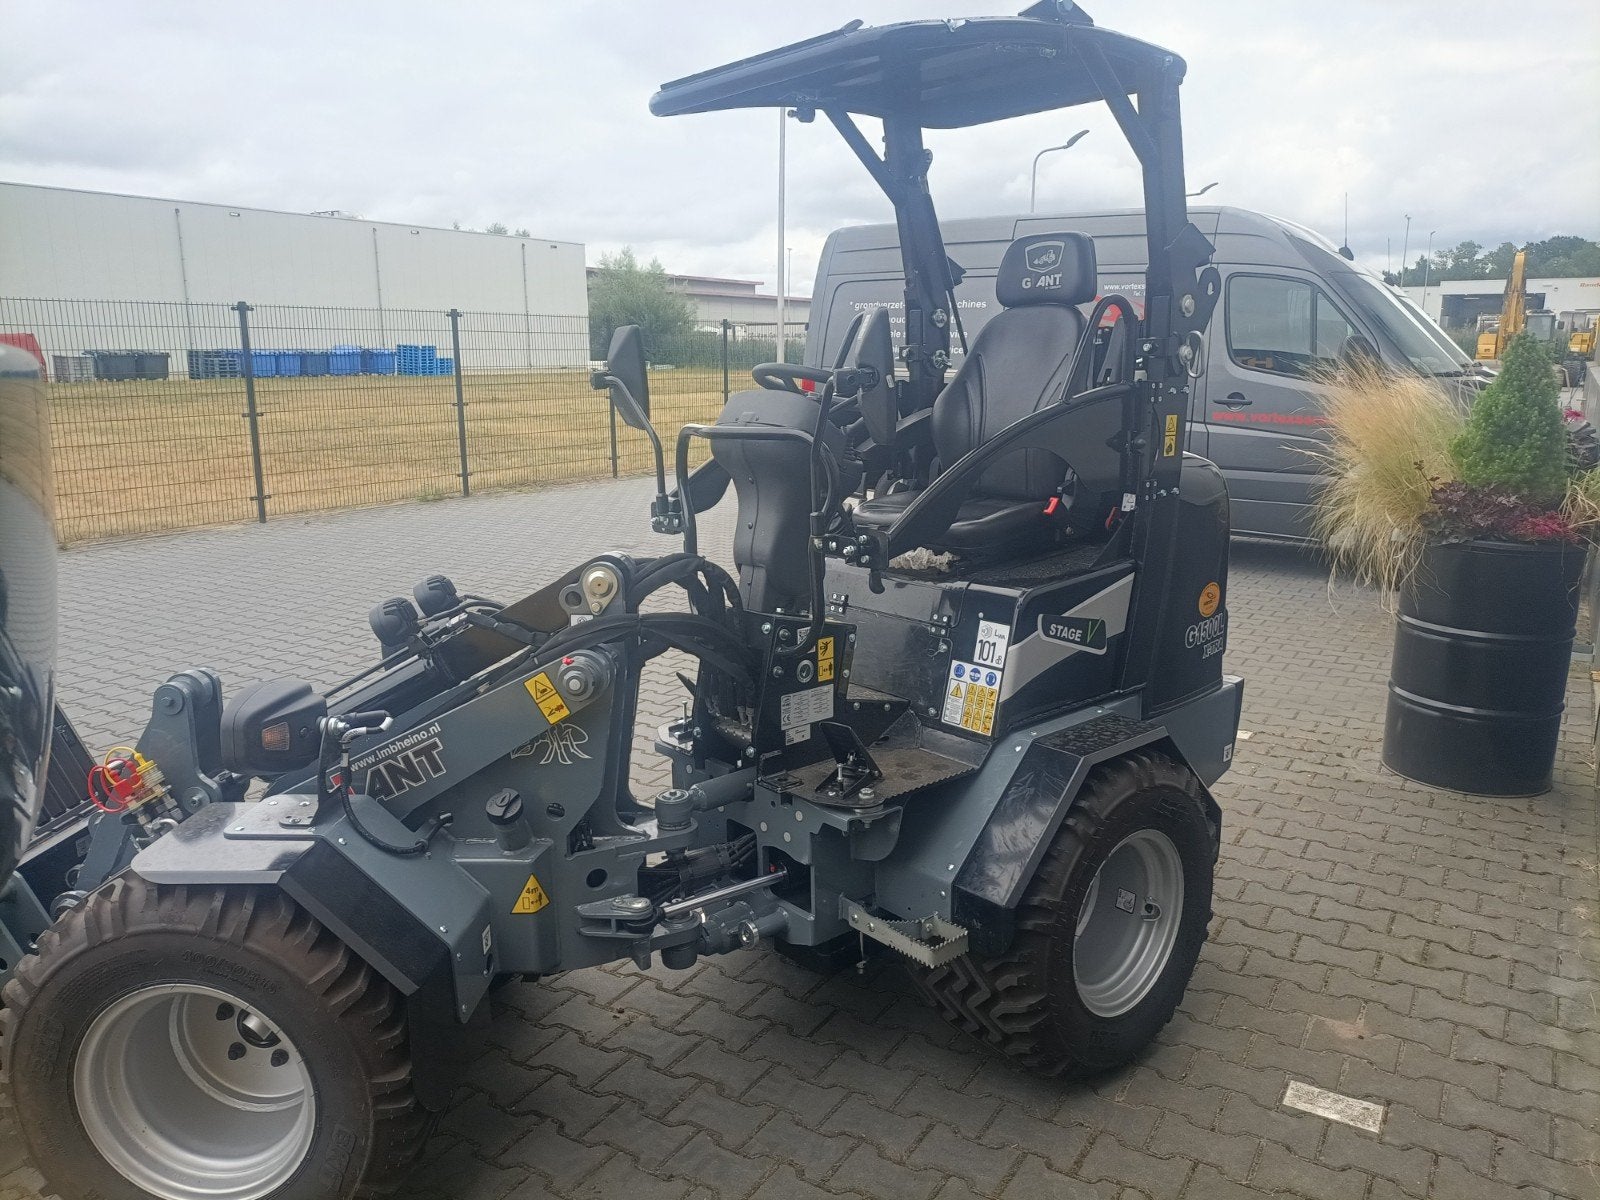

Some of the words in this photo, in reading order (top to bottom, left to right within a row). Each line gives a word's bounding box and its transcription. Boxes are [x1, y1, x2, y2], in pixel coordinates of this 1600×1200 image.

[1021, 272, 1062, 289] GANT
[1049, 623, 1083, 642] STAGE
[977, 639, 997, 664] 101
[350, 722, 442, 772] www.lmbheino.nl
[525, 886, 539, 895] 4m
